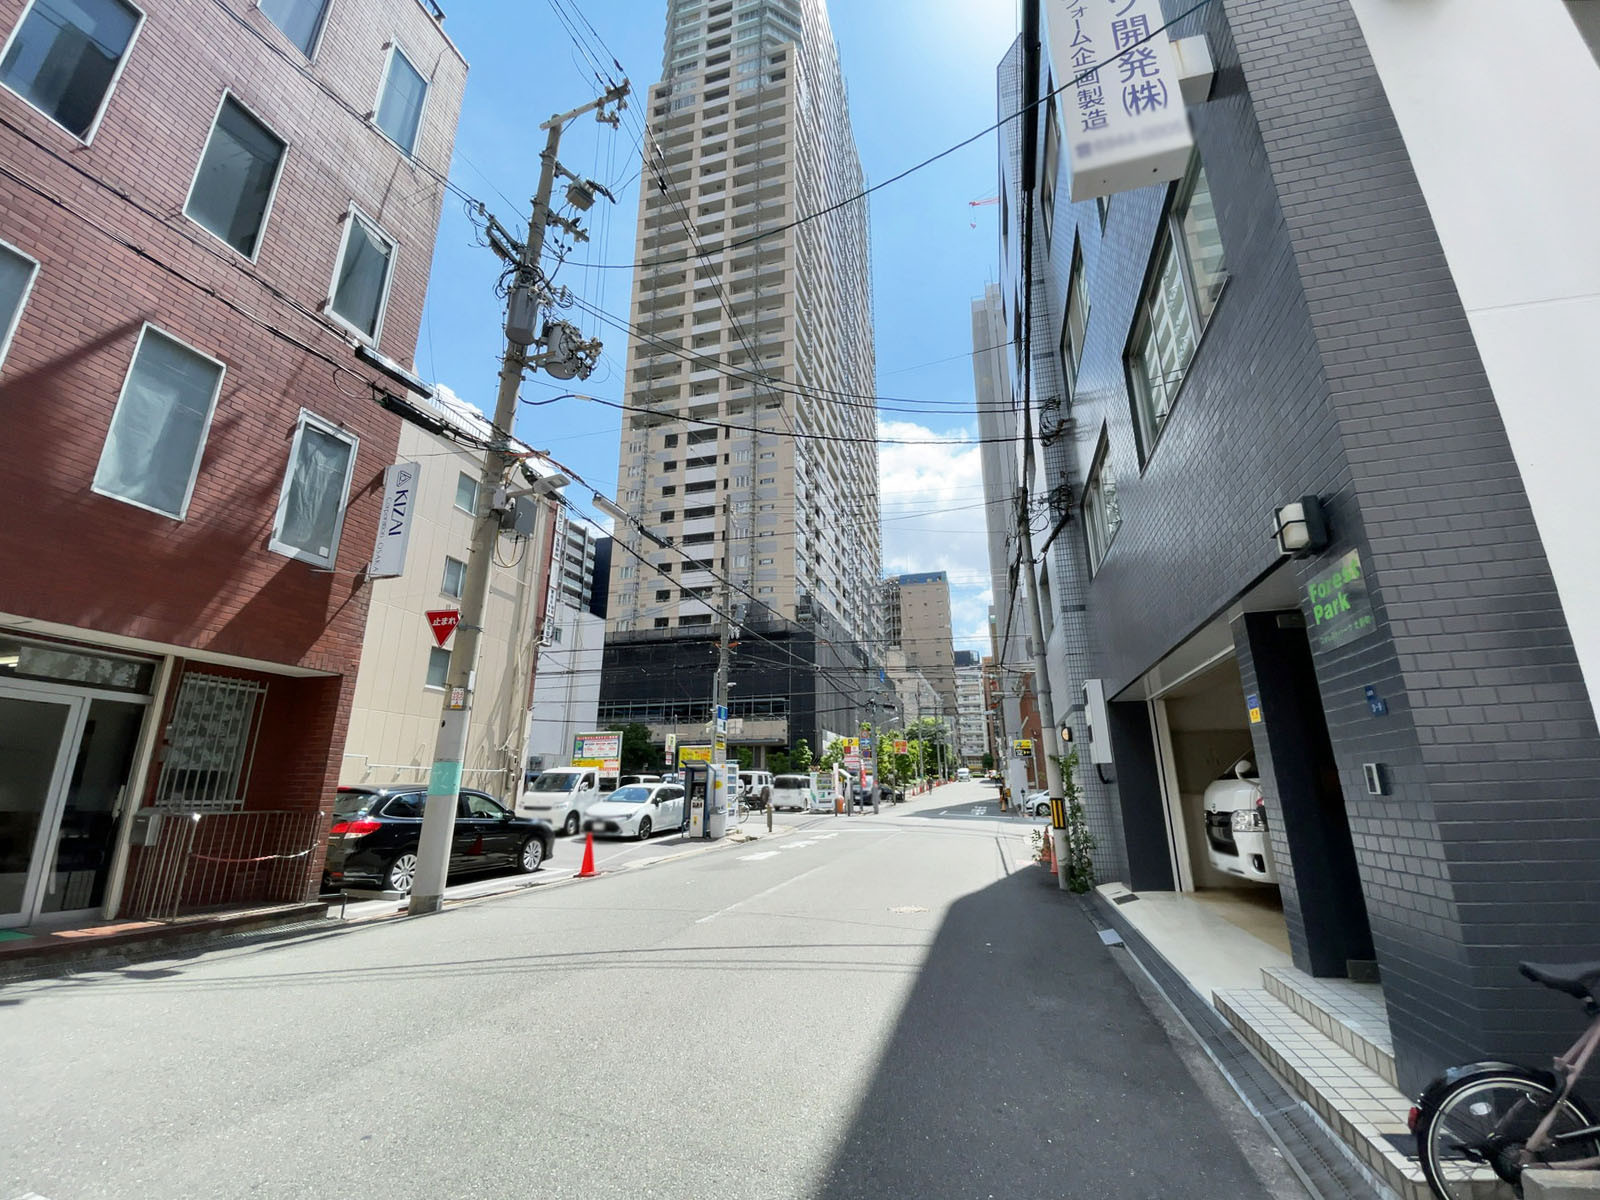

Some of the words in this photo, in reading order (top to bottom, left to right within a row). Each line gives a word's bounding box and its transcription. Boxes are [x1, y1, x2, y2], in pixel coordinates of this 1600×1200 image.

[388, 490, 409, 536] KIZAI
[371, 542, 385, 572] OSAKA
[1308, 558, 1361, 604] Forest
[432, 616, 456, 626] 止まれ
[1313, 591, 1351, 625] Park
